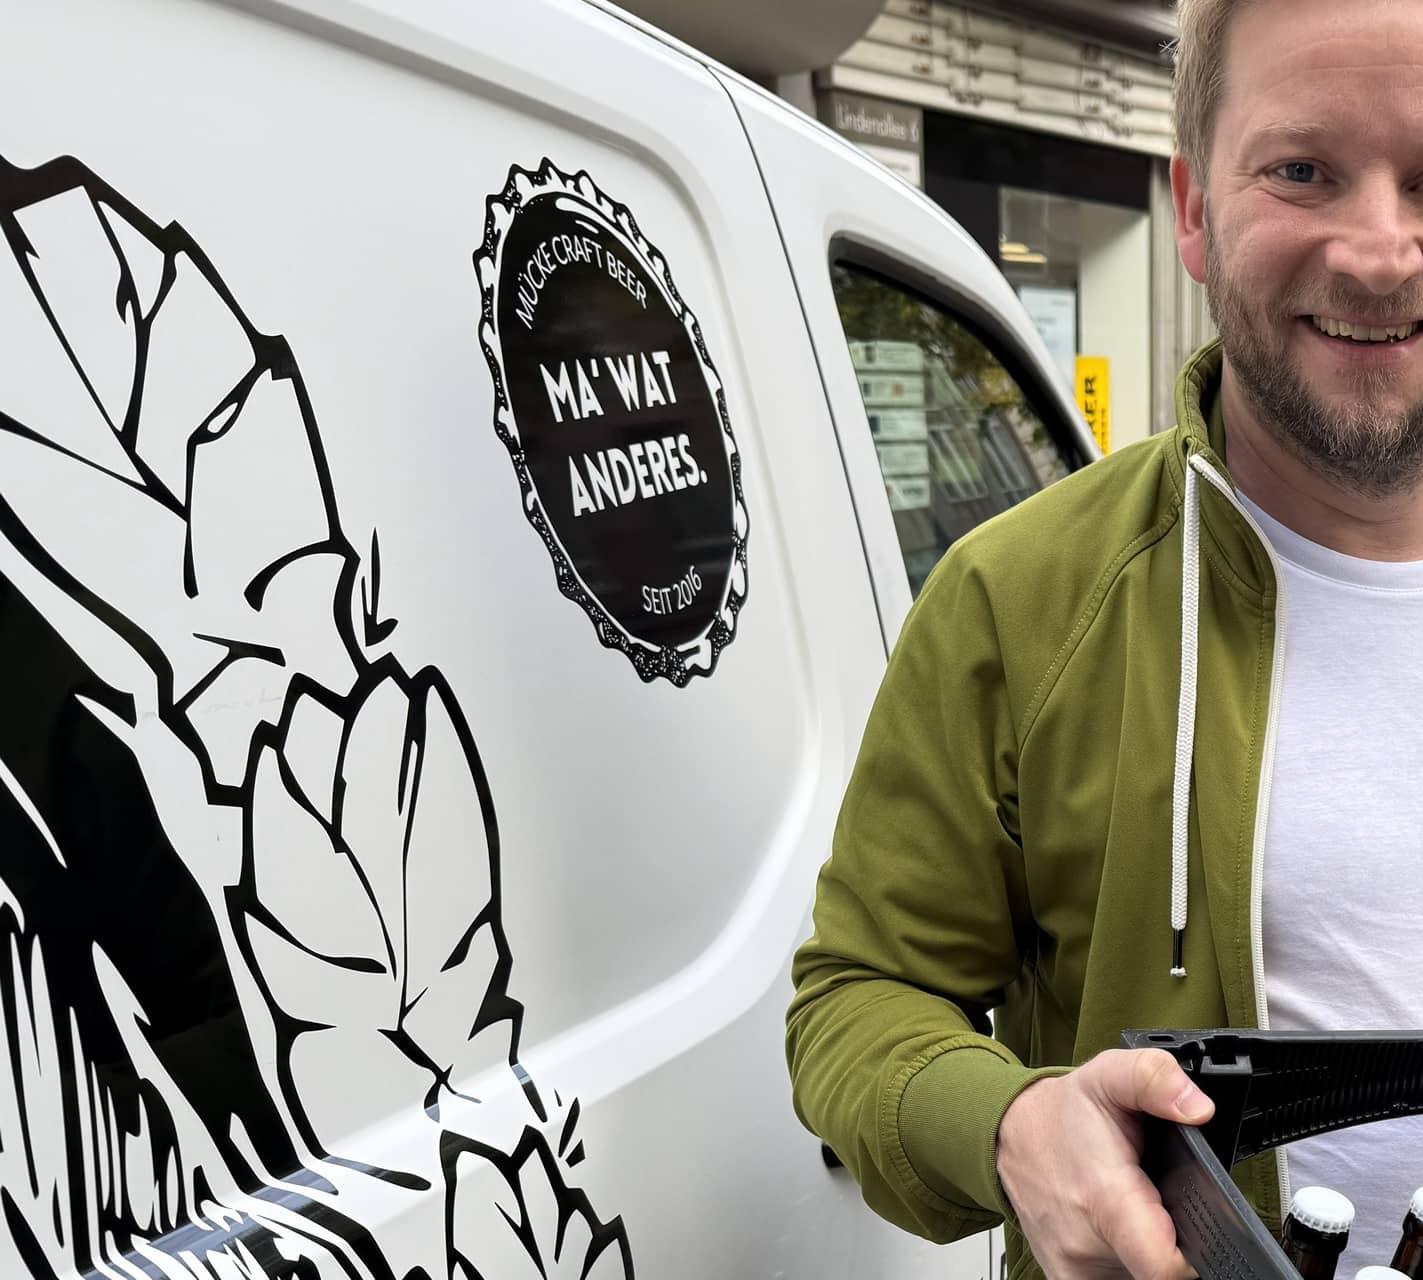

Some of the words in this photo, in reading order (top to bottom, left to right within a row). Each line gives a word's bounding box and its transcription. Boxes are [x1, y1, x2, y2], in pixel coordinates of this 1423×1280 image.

[835, 102, 906, 141] Lindenallee
[515, 241, 557, 330] MÜCKE
[551, 234, 602, 269] CRAFT
[605, 250, 647, 310] BEER
[604, 350, 678, 412] WAT
[568, 433, 708, 517] ANDERES.
[642, 585, 673, 615] SEIT
[672, 565, 702, 610] 2016
